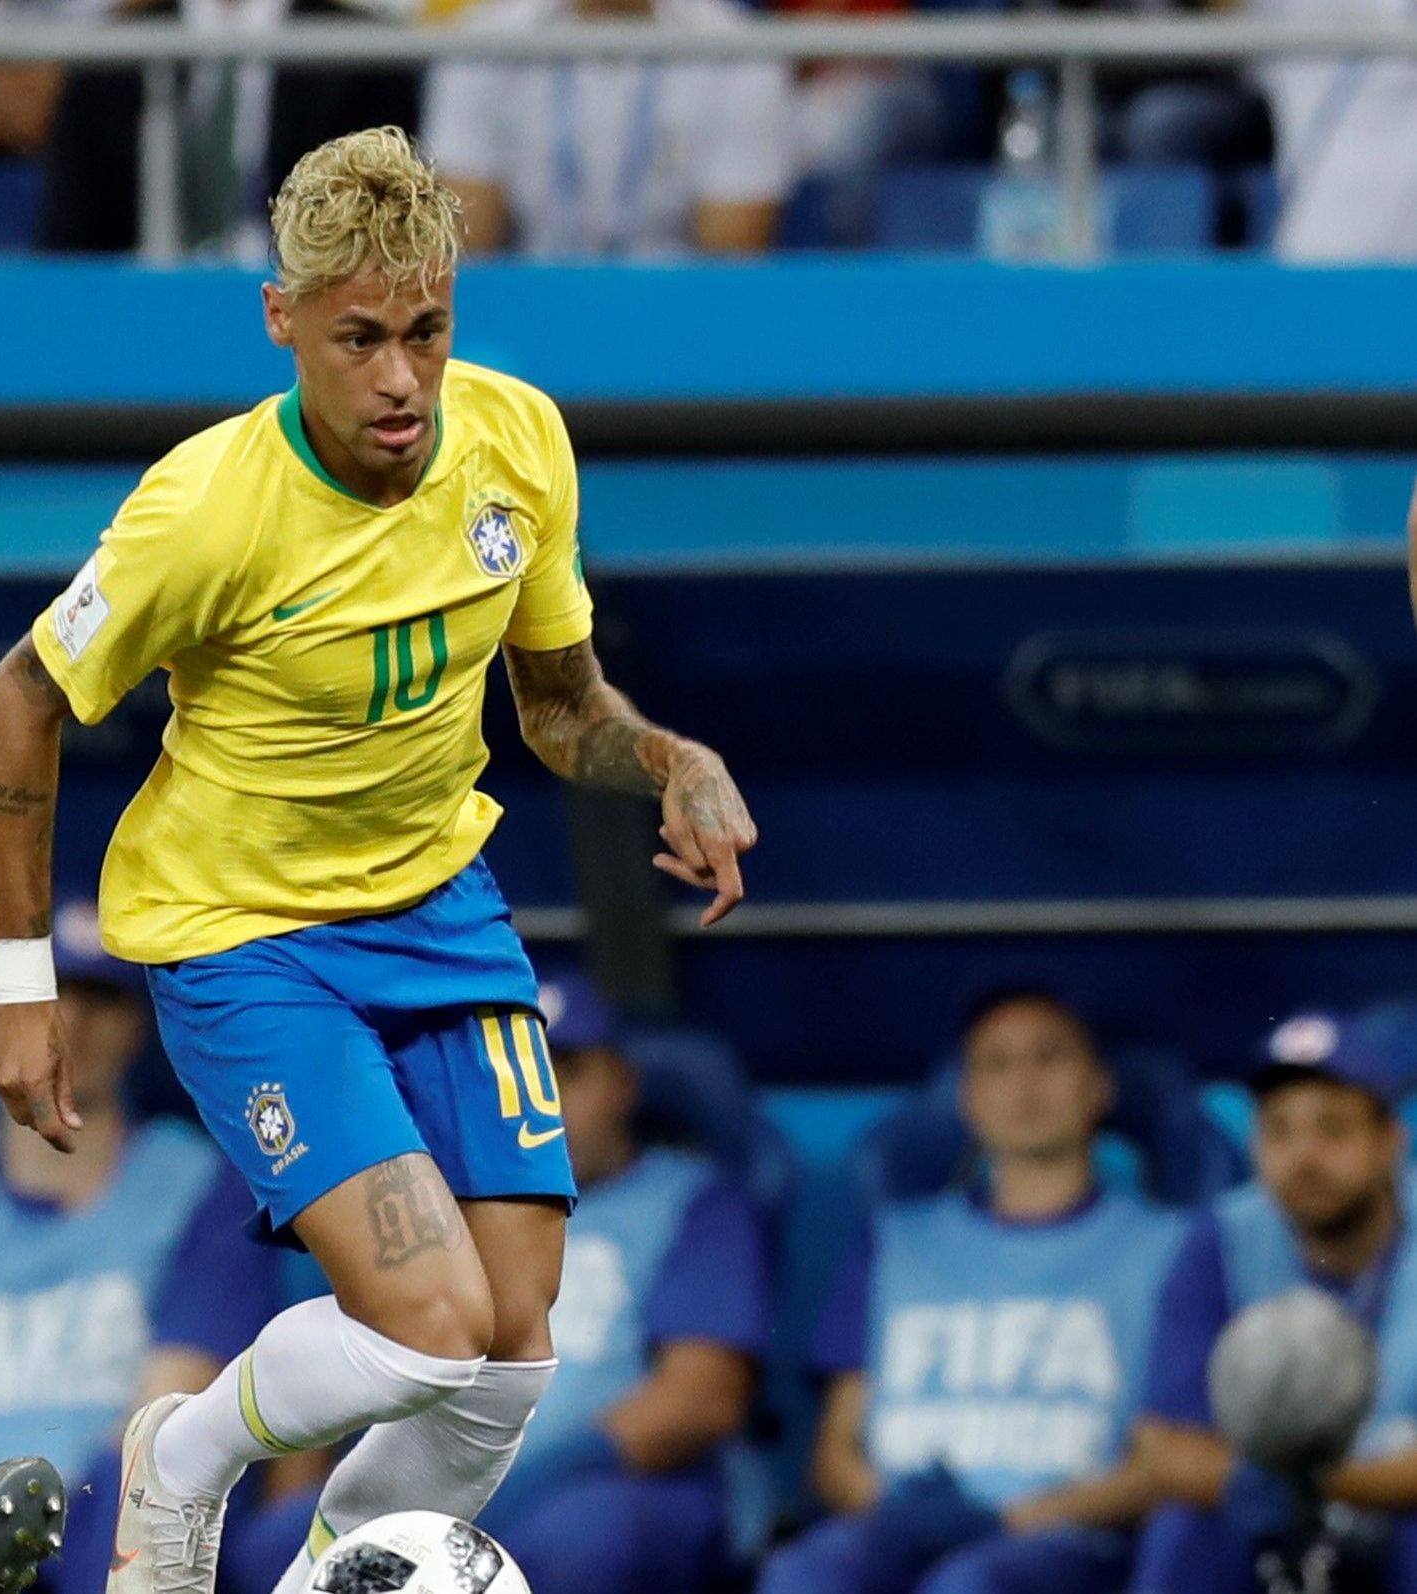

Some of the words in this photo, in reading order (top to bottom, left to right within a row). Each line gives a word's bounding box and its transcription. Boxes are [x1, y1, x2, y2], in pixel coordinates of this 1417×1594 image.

[366, 610, 449, 726] 10
[478, 1008, 562, 1118] 10
[270, 1142, 310, 1176] BRASIL
